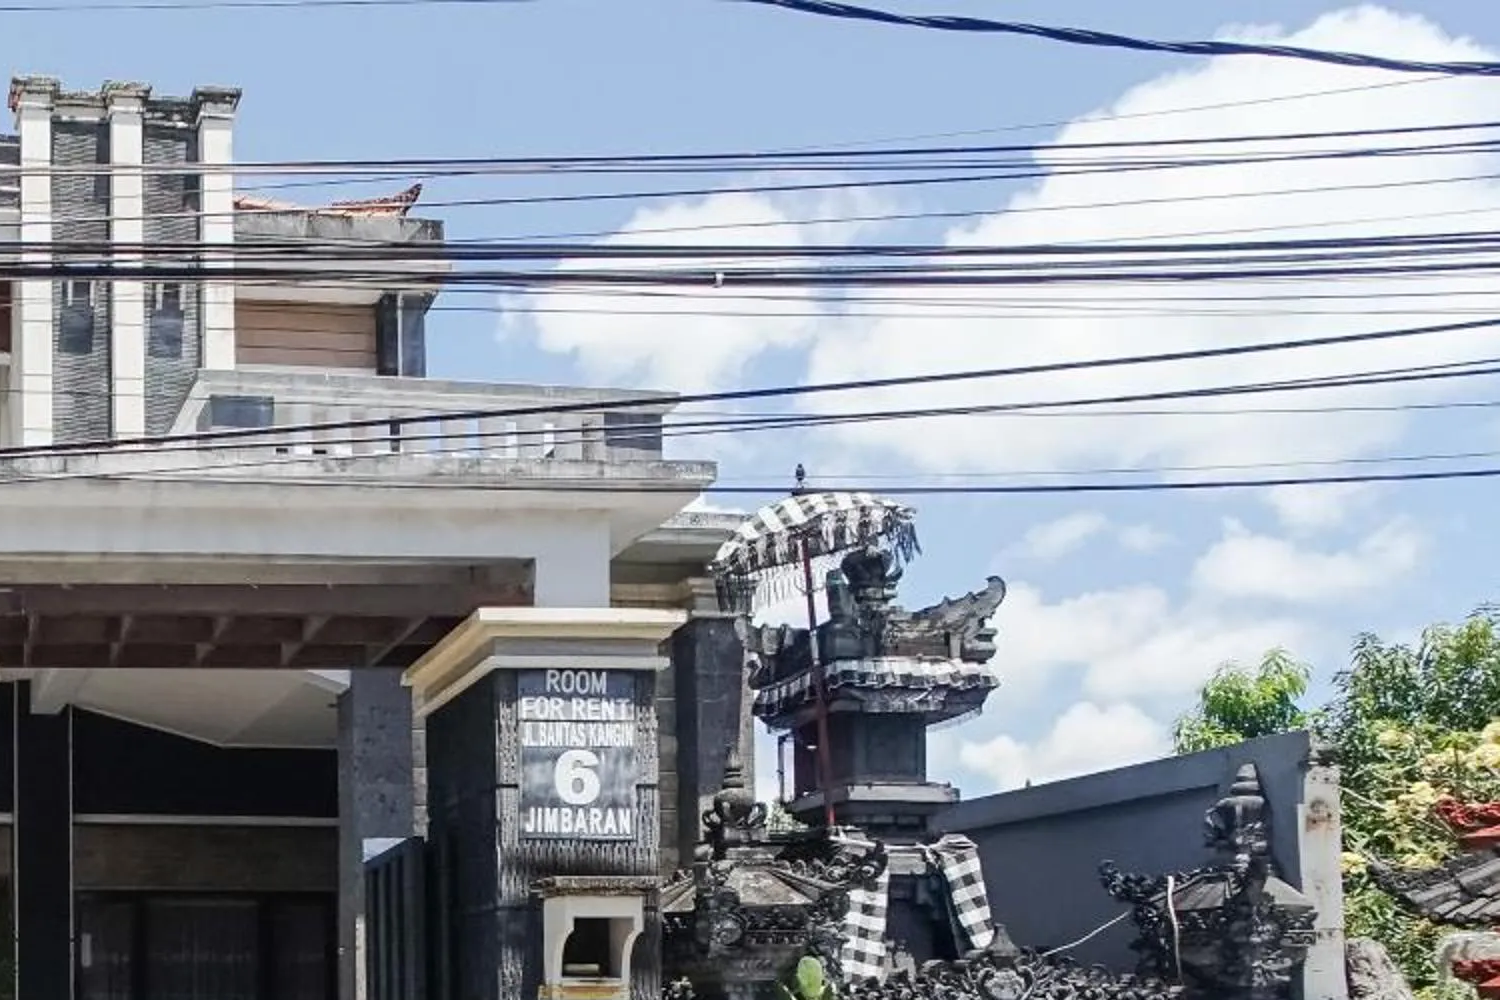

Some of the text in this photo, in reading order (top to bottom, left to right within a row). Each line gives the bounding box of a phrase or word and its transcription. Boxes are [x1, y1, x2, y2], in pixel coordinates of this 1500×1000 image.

[546, 669, 607, 695] ROOM
[521, 696, 631, 721] FOR RENT
[555, 749, 600, 805] 6
[525, 806, 631, 834] JIMBARAN
